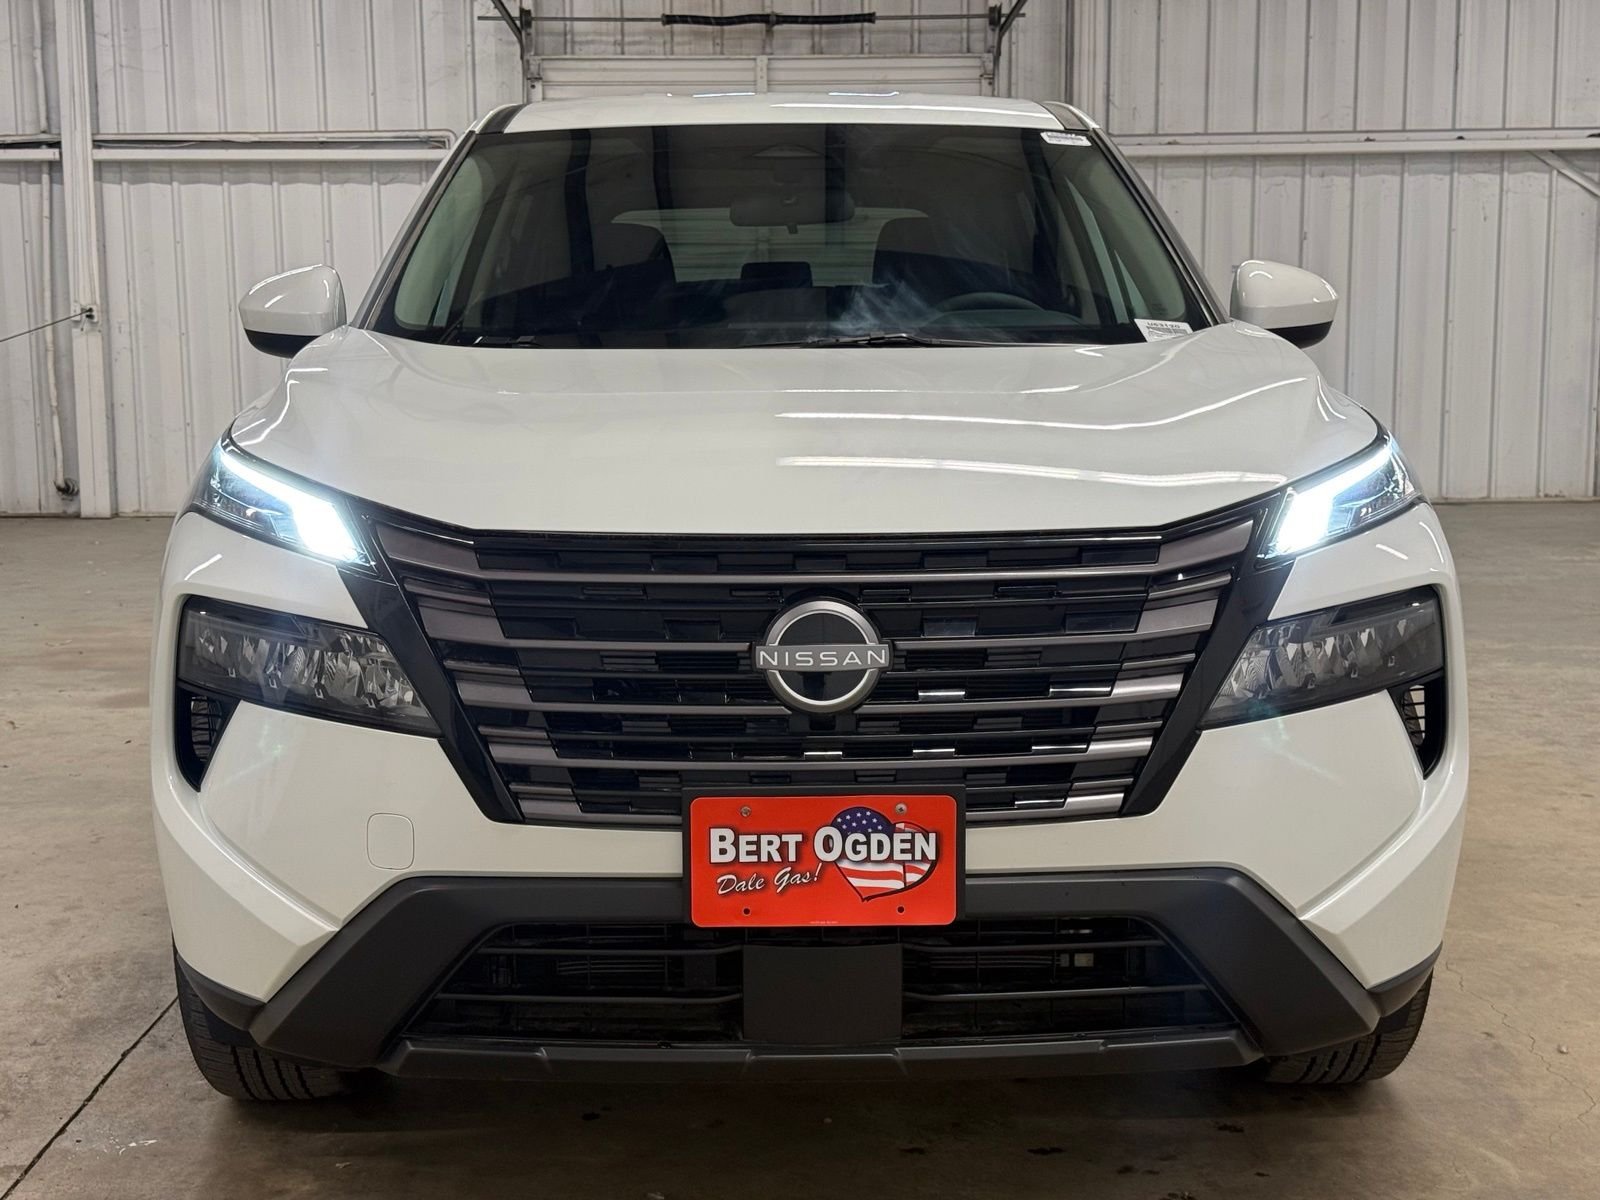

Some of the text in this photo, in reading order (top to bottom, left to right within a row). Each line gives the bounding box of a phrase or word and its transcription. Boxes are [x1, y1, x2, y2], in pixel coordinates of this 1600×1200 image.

[759, 649, 886, 667] NISSAN
[708, 825, 937, 864] BERT OGDEN
[716, 862, 823, 896] Dale Gas!
